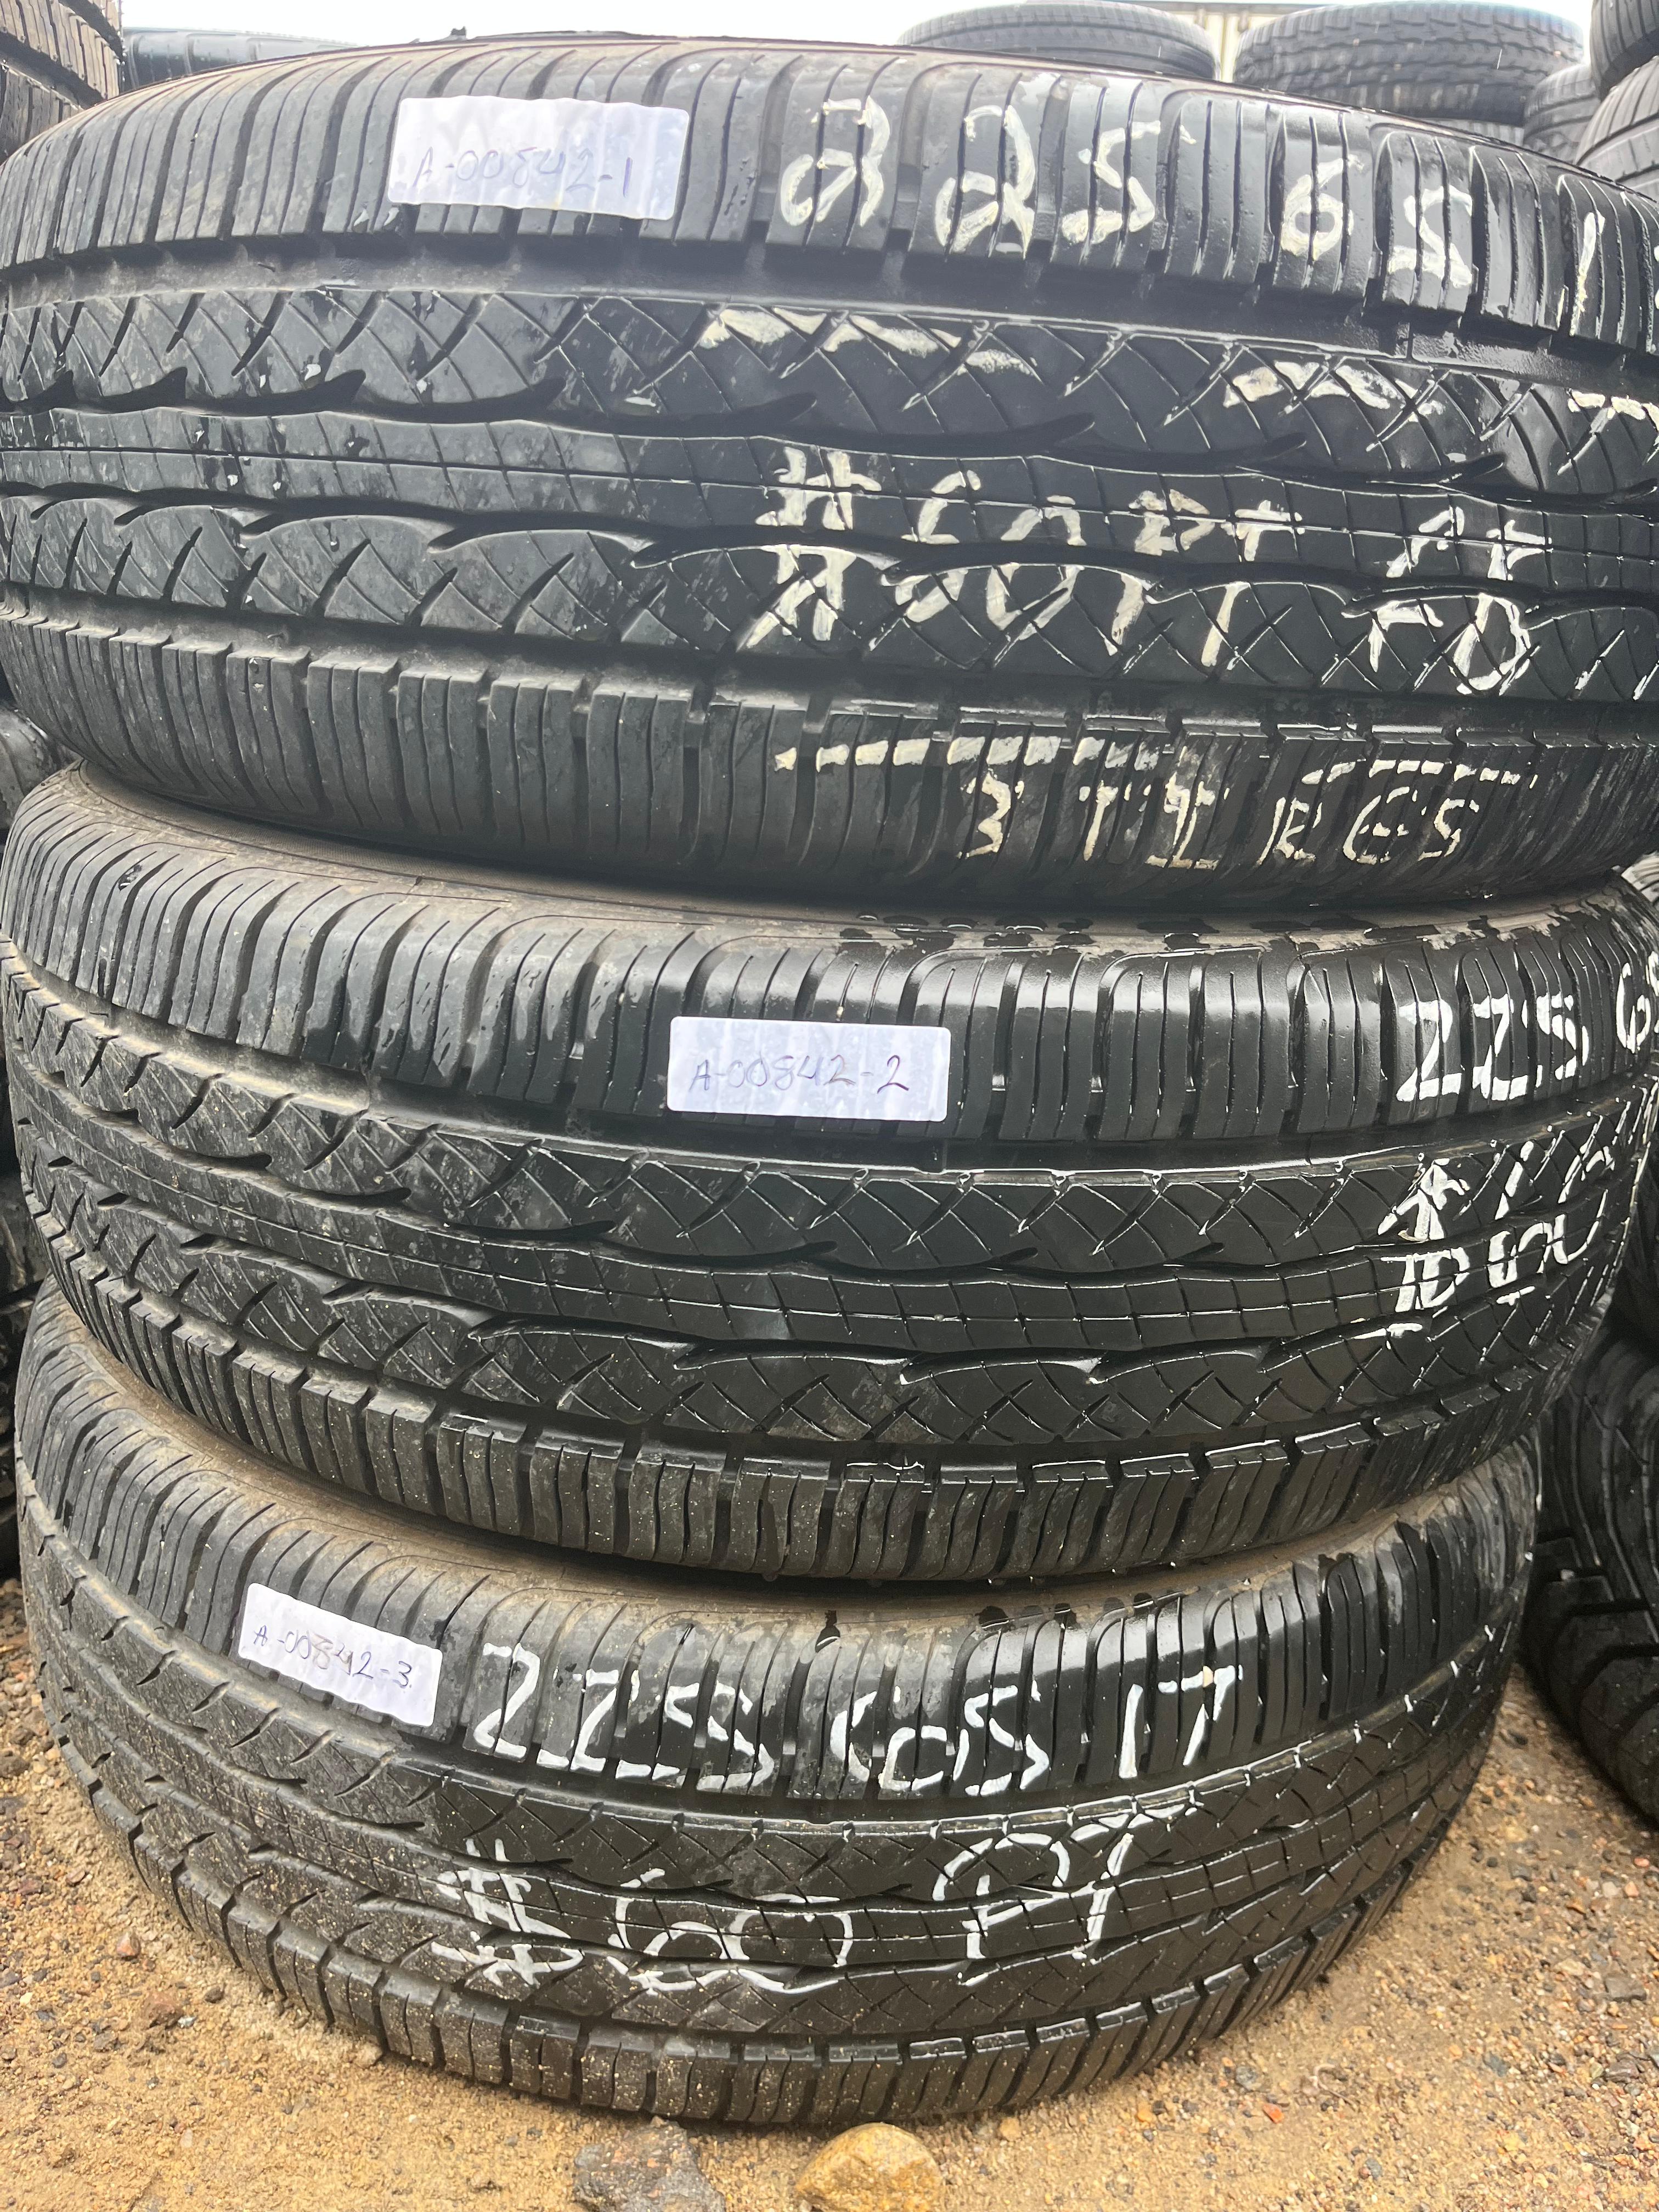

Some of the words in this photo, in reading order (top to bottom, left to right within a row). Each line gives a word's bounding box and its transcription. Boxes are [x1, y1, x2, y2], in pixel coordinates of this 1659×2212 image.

[1279, 154, 1475, 289] 65
[689, 1054, 910, 1094] A-00842-2
[1396, 991, 1589, 1102] 225
[473, 1641, 775, 1792] 225
[830, 1680, 1050, 1797] 65
[1118, 1664, 1244, 1780] 17
